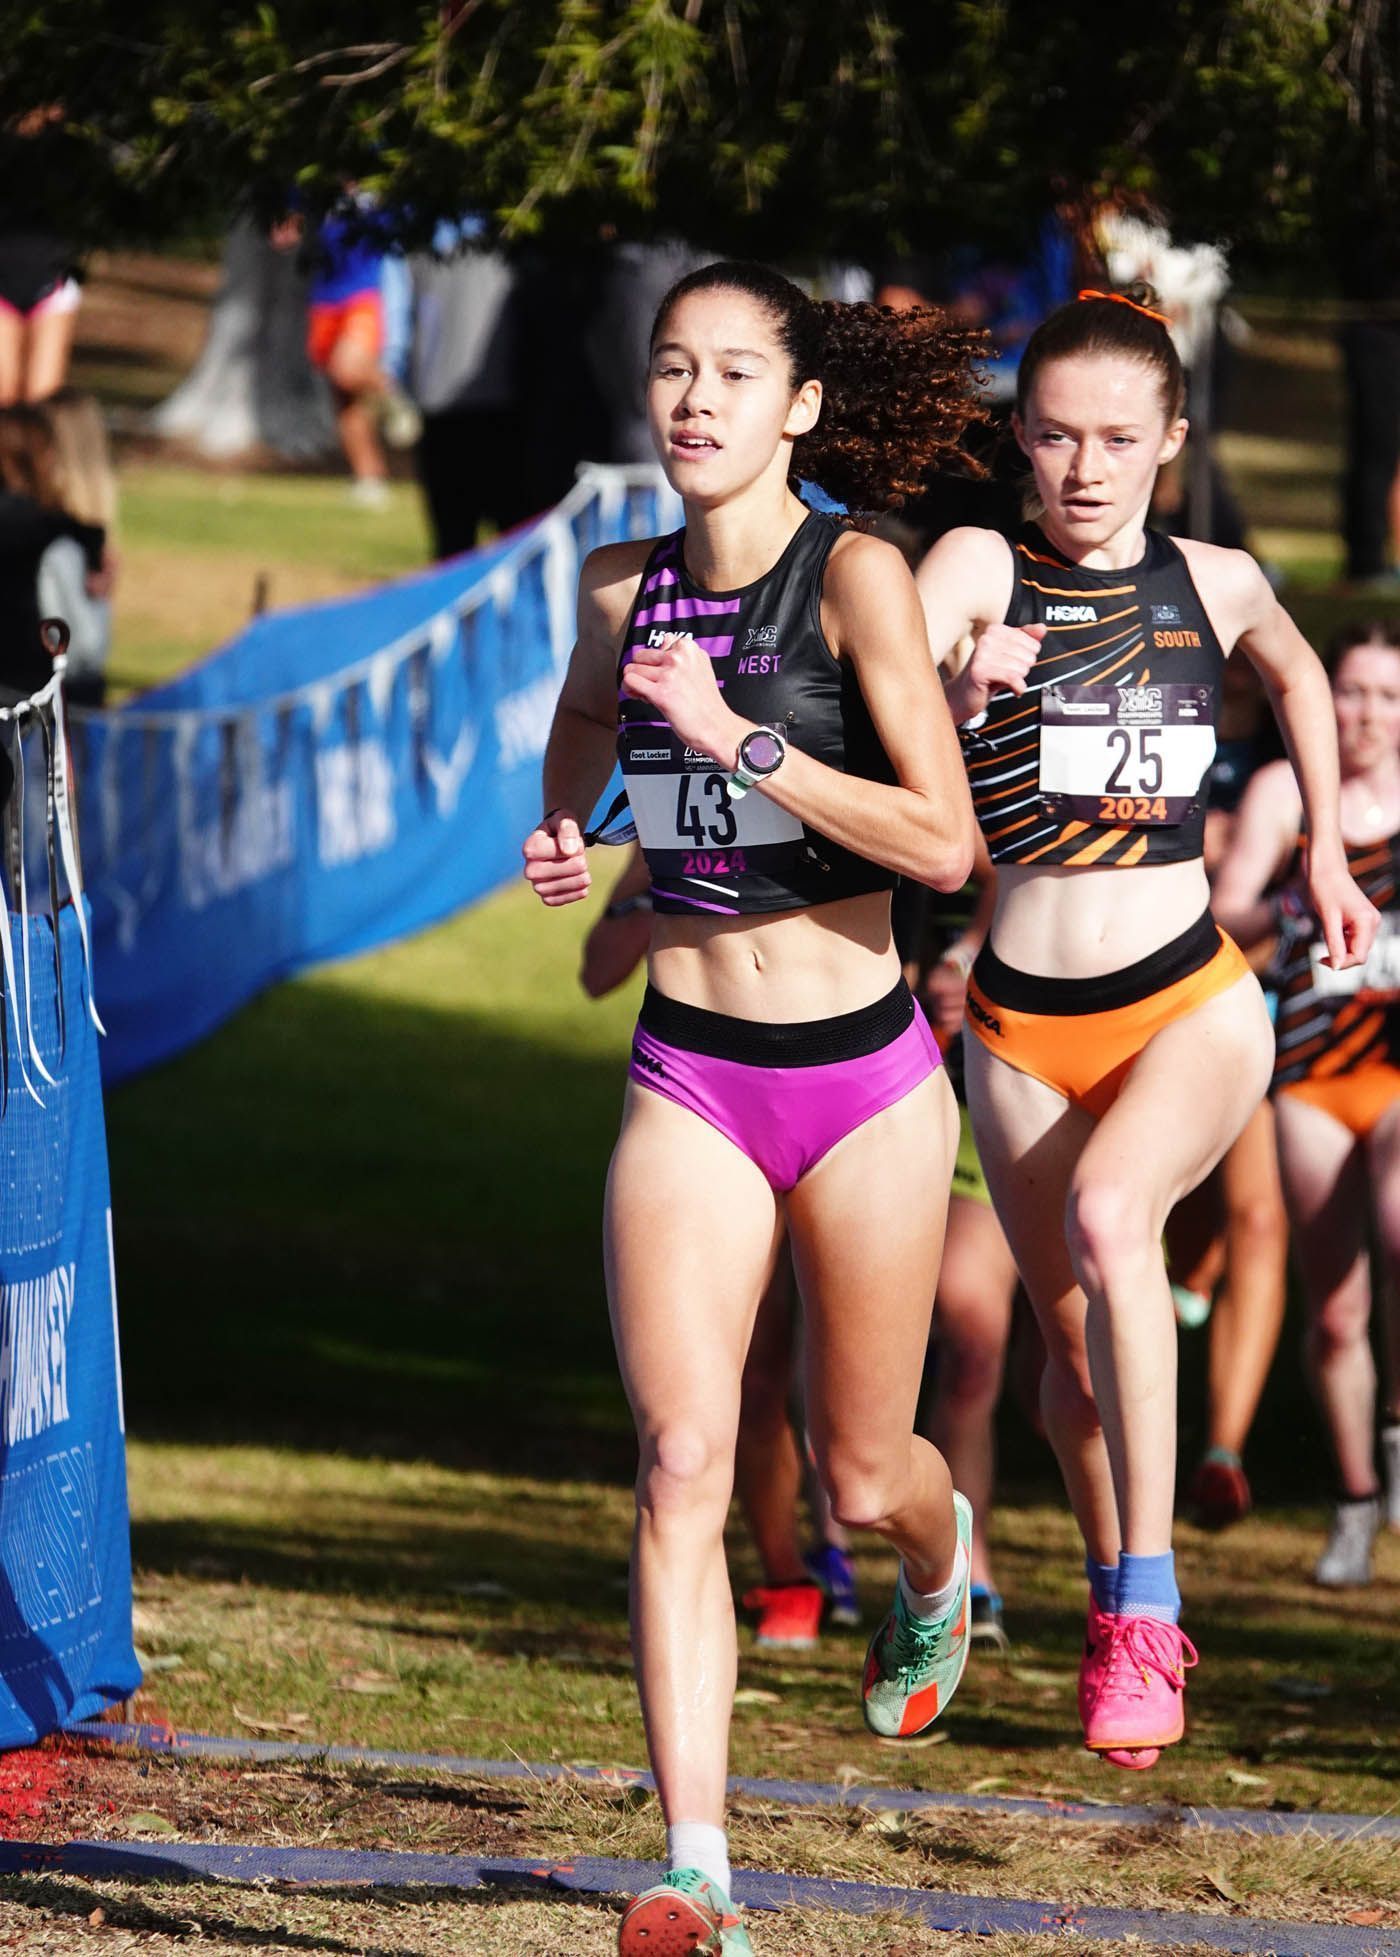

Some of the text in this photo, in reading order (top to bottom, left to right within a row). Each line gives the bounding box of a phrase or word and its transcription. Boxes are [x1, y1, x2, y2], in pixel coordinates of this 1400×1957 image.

[1046, 606, 1097, 622] HOKA
[1153, 631, 1201, 648] SOUTH
[738, 655, 782, 674] WEST
[646, 751, 669, 759] Locker
[1105, 729, 1163, 794] 25
[676, 774, 737, 847] 43
[1099, 797, 1167, 820] 2024
[681, 850, 746, 875] 2024
